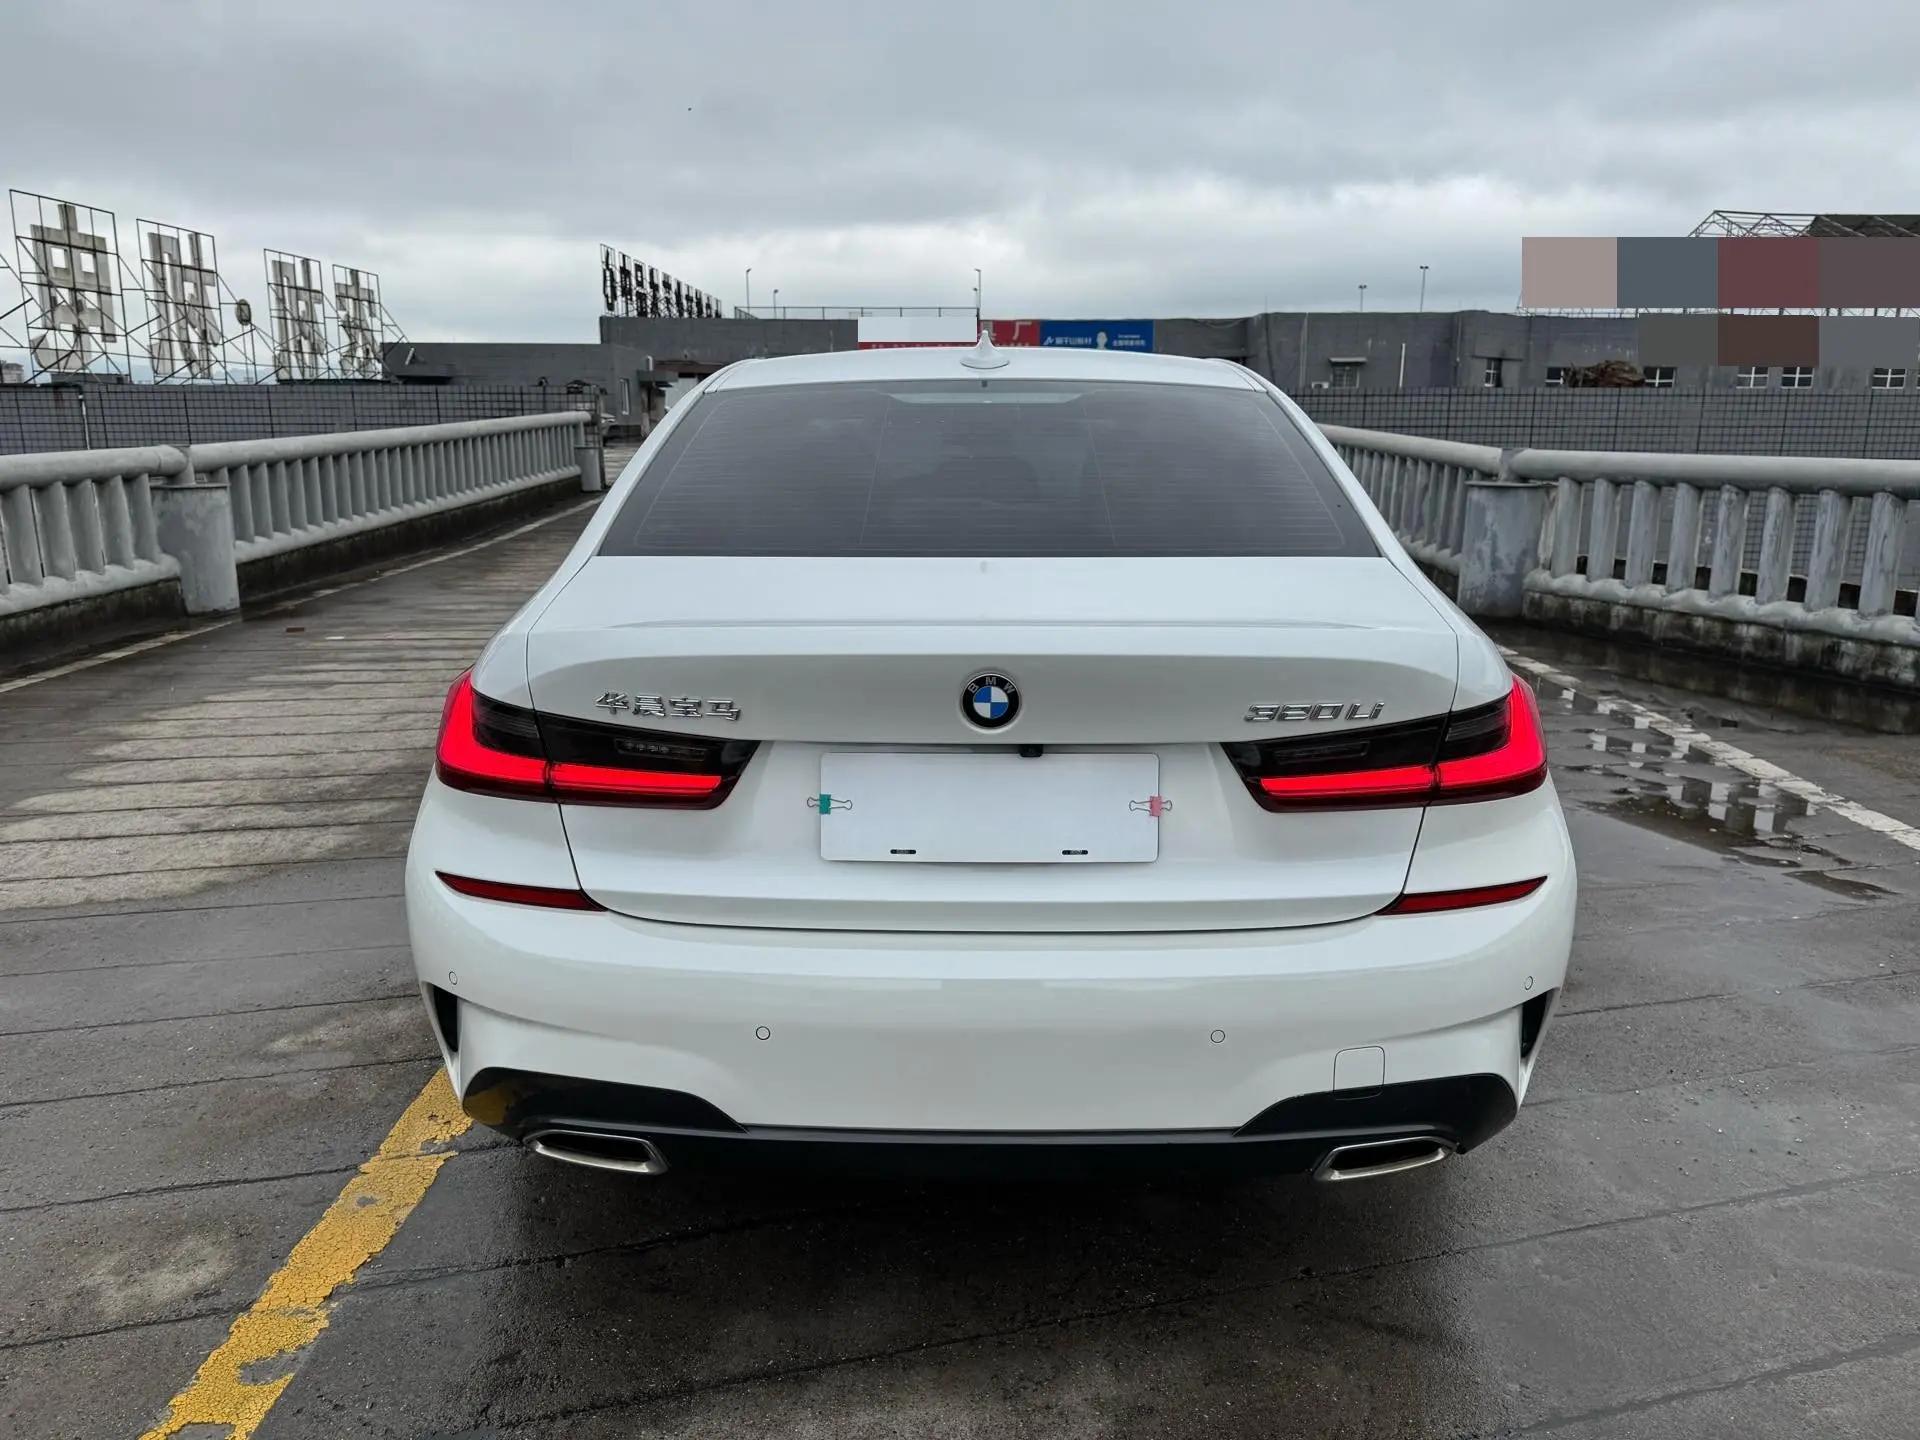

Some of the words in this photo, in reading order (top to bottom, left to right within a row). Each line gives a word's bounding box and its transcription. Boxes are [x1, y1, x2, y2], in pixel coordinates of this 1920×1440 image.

[967, 676, 1016, 694] BMW
[595, 692, 741, 721] 华晨宝马
